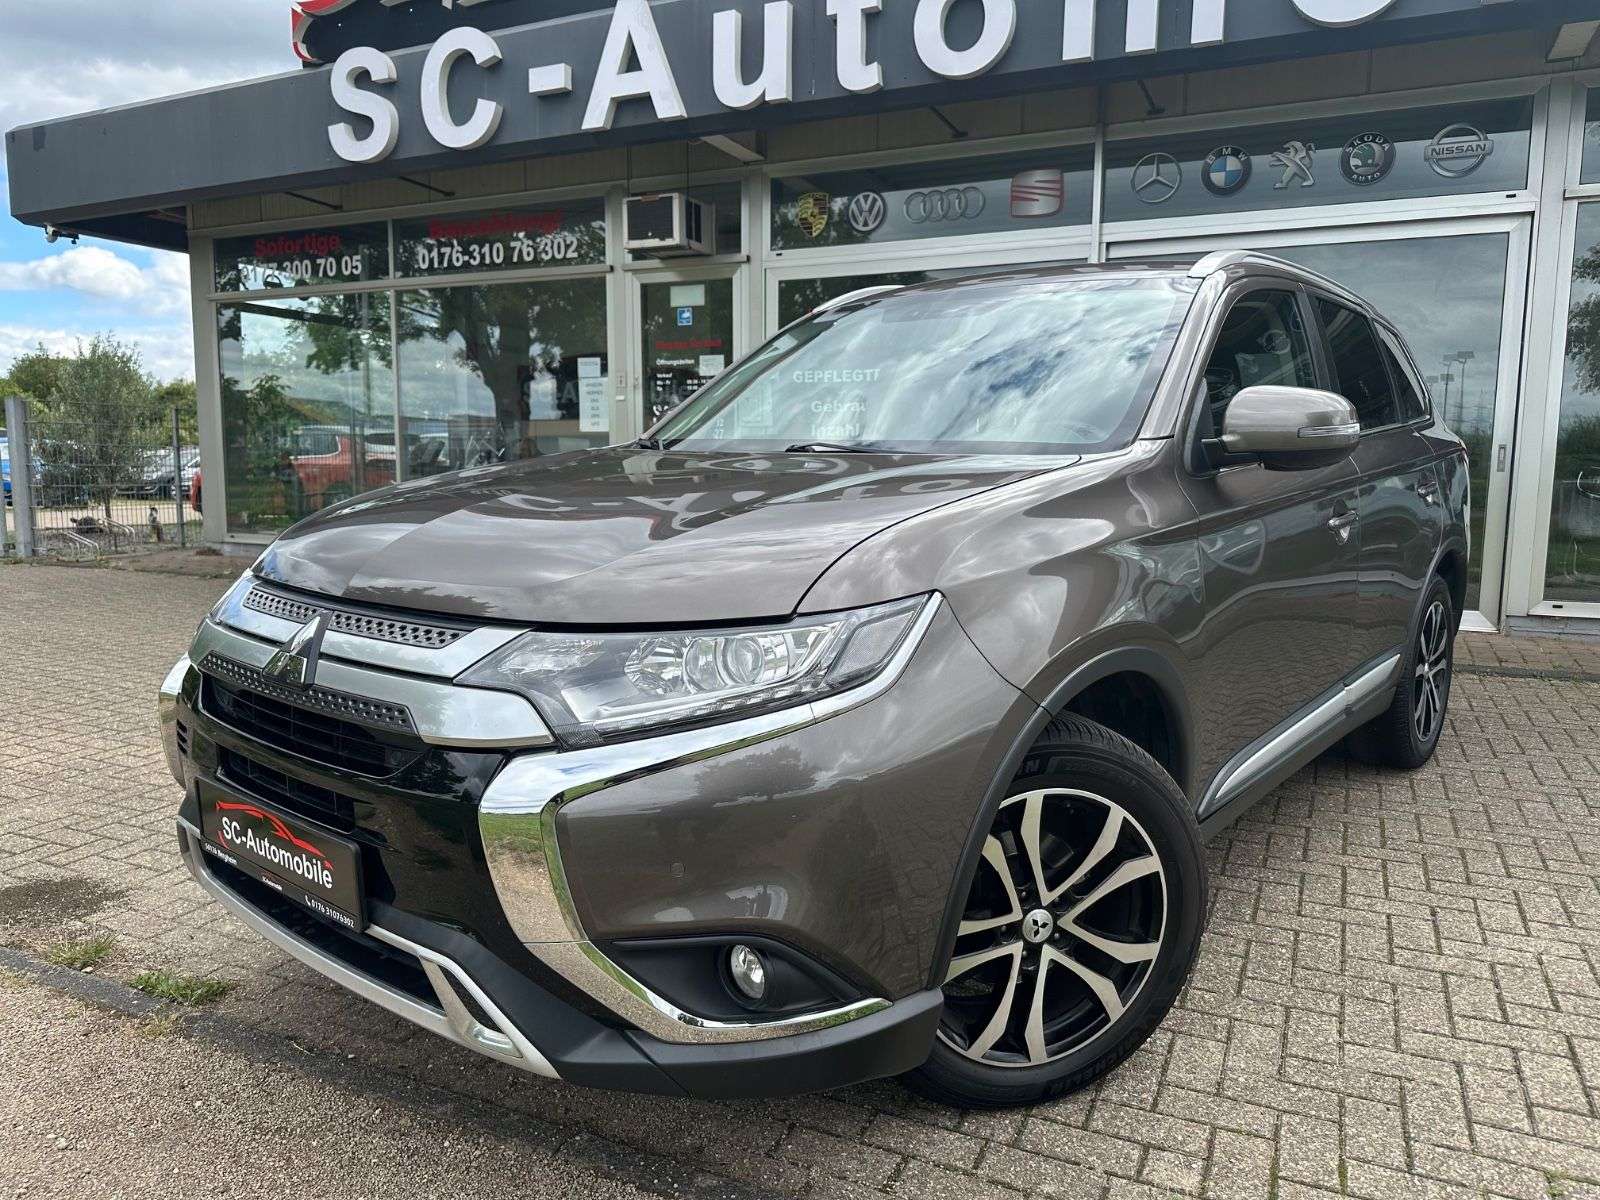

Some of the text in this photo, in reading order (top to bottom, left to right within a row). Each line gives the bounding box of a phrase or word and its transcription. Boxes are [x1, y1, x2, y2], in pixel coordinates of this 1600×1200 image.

[327, 0, 1394, 163] SC-Auto
[1430, 143, 1487, 157] NISSAN
[1351, 172, 1381, 184] AUTO
[316, 257, 337, 278] 70
[341, 254, 362, 276] 05
[417, 235, 579, 270] 0176-310 76 302
[222, 816, 333, 889] SC-Automobile
